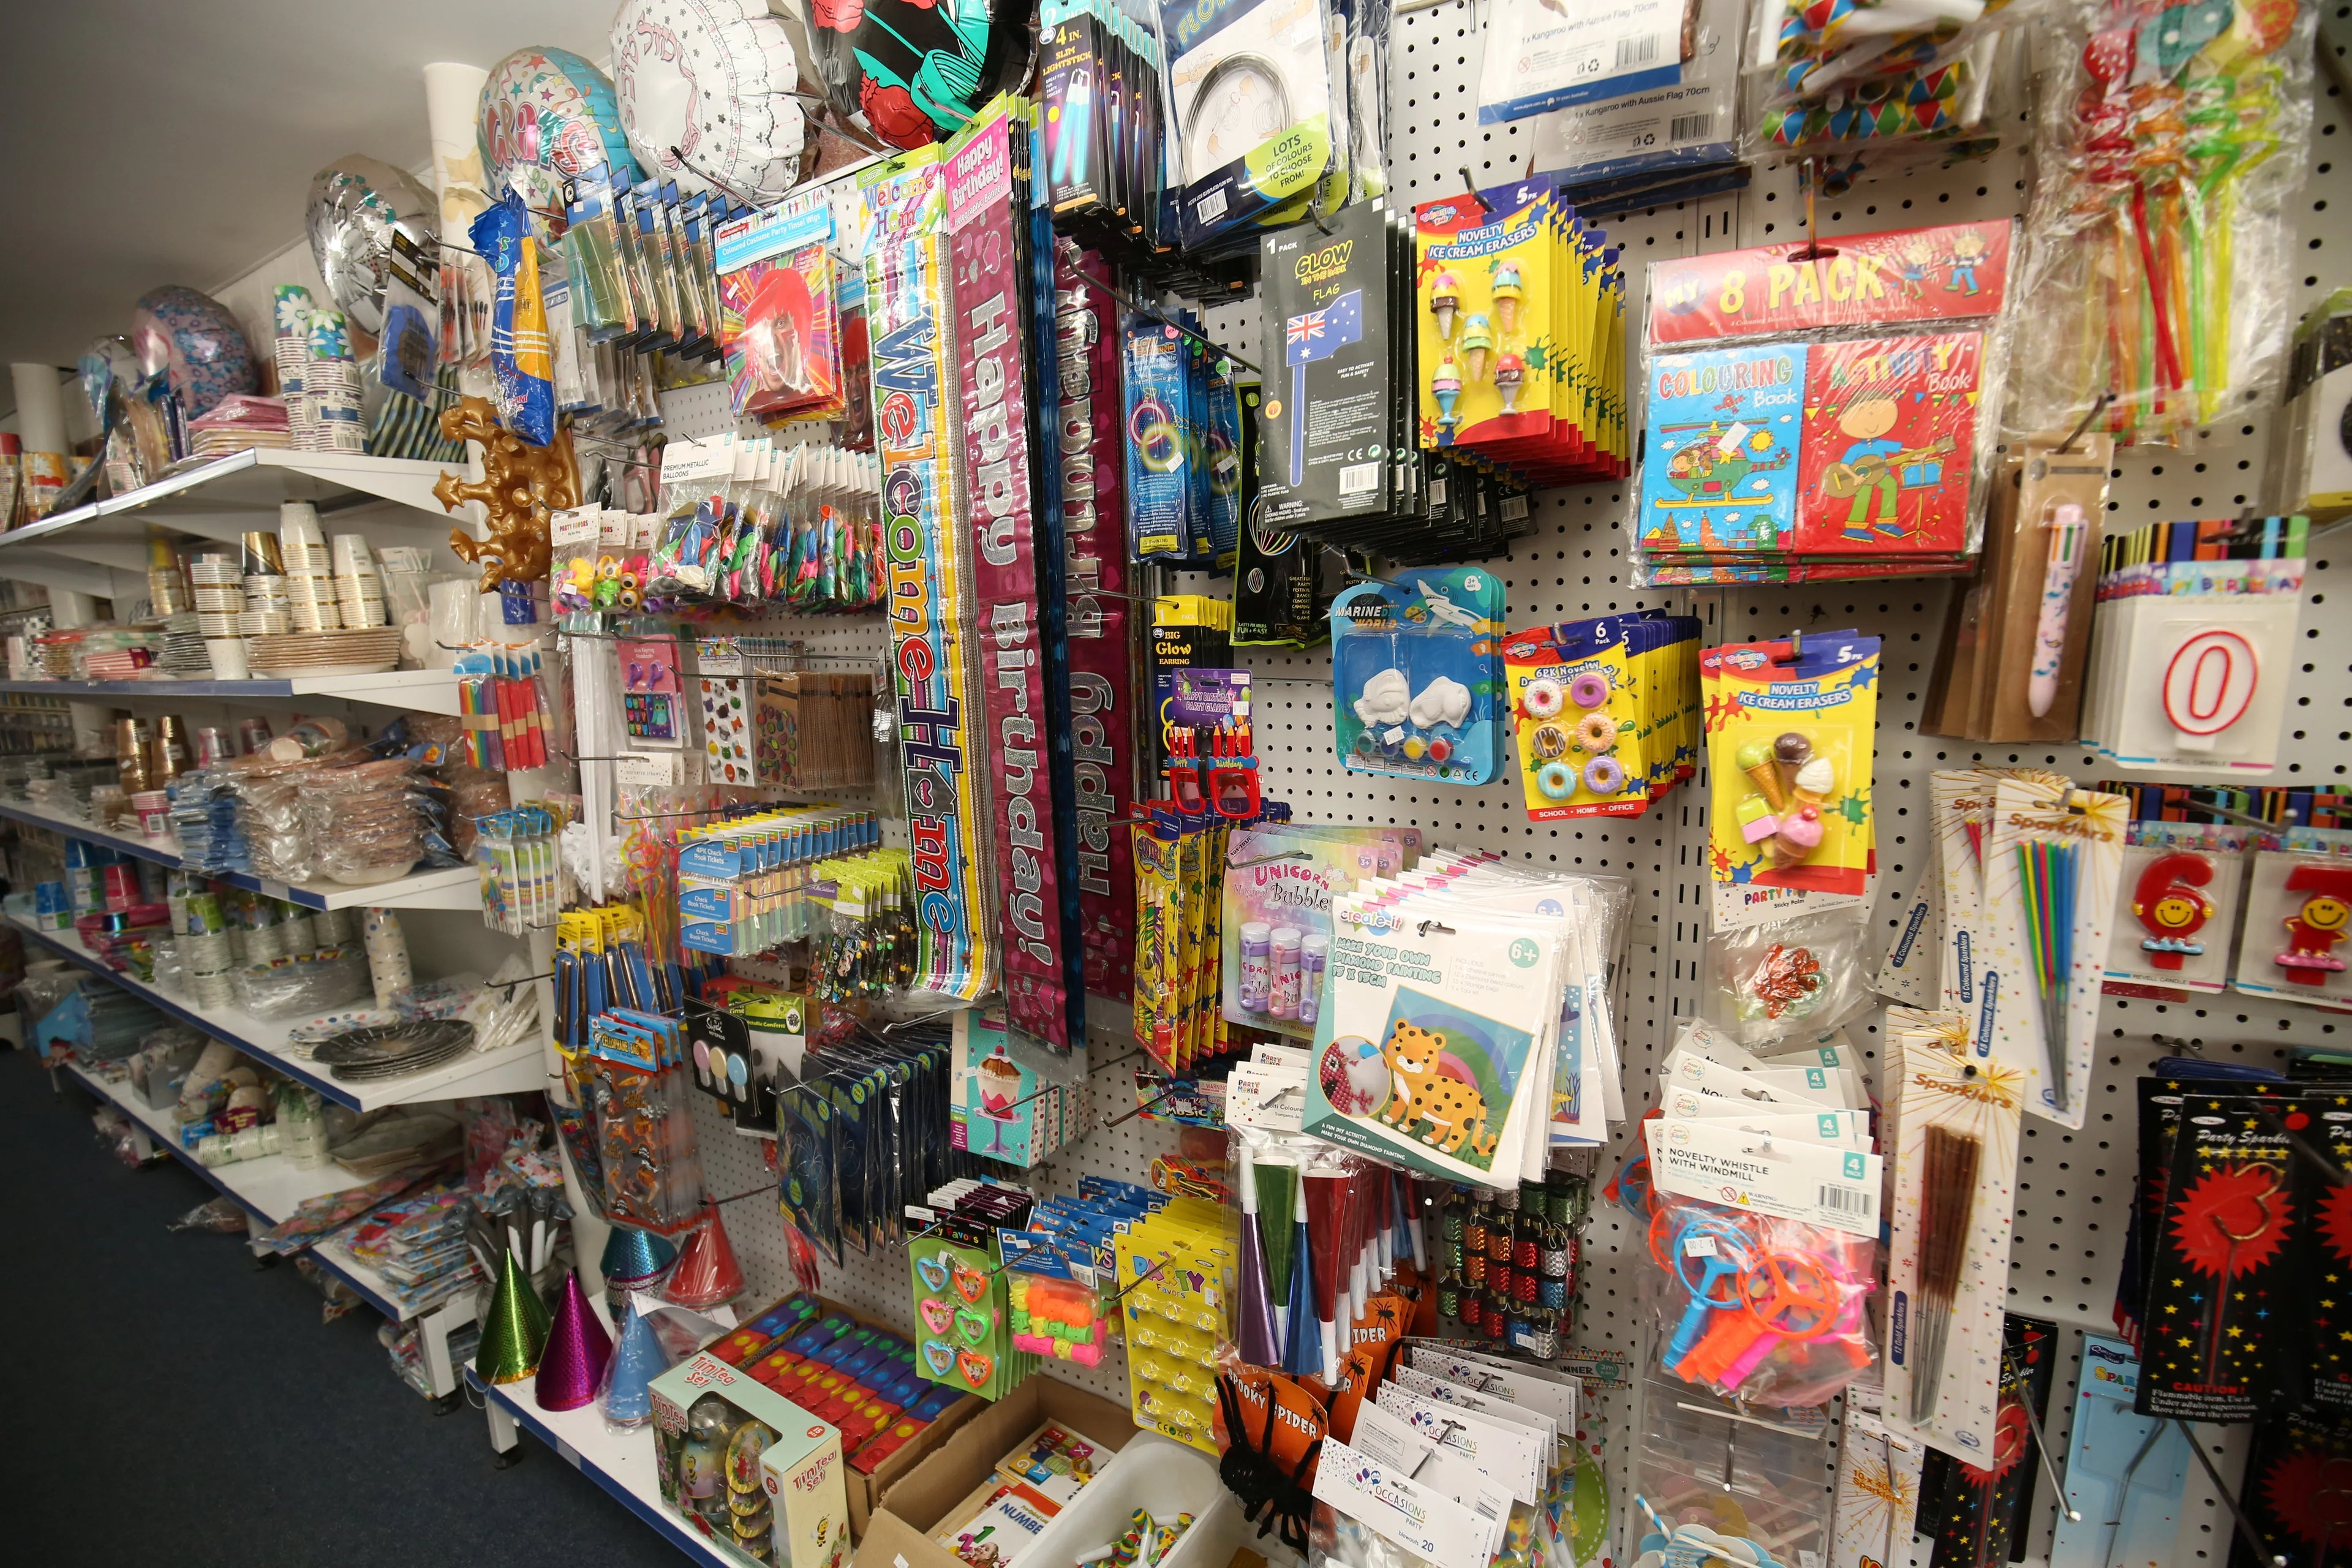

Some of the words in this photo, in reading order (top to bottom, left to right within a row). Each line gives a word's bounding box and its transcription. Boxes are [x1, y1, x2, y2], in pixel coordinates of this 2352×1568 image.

[1055, 26, 1066, 45] 4
[1069, 30, 1082, 42] IN.
[1055, 46, 1076, 60] SLIM
[1042, 51, 1091, 76] LIGHTSTICK
[1585, 104, 1619, 120] Kangaroo
[1621, 100, 1637, 111] with
[1638, 95, 1665, 108] Aussie
[1666, 90, 1684, 104] Flag
[1685, 85, 1710, 97] 70cm
[1272, 134, 1302, 157] LOTS
[956, 134, 992, 179] Happy
[1265, 162, 1277, 172] OF
[1280, 142, 1313, 167] COLOURS
[1269, 171, 1279, 182] TO
[1281, 155, 1313, 177] CHOOSE
[1280, 170, 1305, 187] FROM!
[951, 151, 1004, 212] Birthday!
[862, 172, 934, 213] Welcome
[954, 197, 984, 228] Holographic
[984, 183, 1005, 203] Banner
[722, 240, 746, 255] Coloured
[746, 232, 770, 246] Costume
[771, 225, 787, 236] Party
[788, 219, 805, 230] Tinsel
[806, 213, 820, 224] Wigs
[1429, 246, 1446, 258] ICE
[1447, 243, 1483, 258] CREAM
[1486, 225, 1536, 253] ERASERS
[1458, 223, 1503, 243] NOVELTY
[1267, 238, 1275, 254] 1
[1279, 241, 1297, 252] PACK
[1295, 239, 1353, 277] GLOW
[1301, 277, 1312, 285] IN
[1313, 271, 1326, 282] THE
[1328, 265, 1347, 276] DARK
[1664, 280, 1699, 307] MY
[1720, 270, 1746, 314] 8
[1768, 253, 1887, 309] PACK
[1313, 283, 1340, 301] FLAG
[1830, 342, 1954, 390] ACTIVITY
[1658, 355, 1793, 399] COLOURING
[1926, 368, 1972, 392] Book
[1754, 388, 1798, 406] Book
[971, 291, 1017, 566] Happy
[663, 463, 686, 472] PREMIUM
[686, 459, 709, 469] METALLIC
[663, 470, 689, 480] BALLOONS
[875, 303, 939, 682] Welcome
[1335, 606, 1382, 617] MARINE
[1355, 619, 1397, 629] WORLD
[1596, 622, 1607, 638] 6
[1156, 643, 1191, 655] Glow
[1536, 667, 1557, 678] 6PK
[1559, 660, 1599, 676] Novelty
[1771, 684, 1818, 695] NOVELTY
[2162, 630, 2258, 735] 0
[1184, 692, 1202, 701] HAPPY
[1204, 692, 1234, 701] BIRTHDAY
[1739, 693, 1755, 705] ICE
[1758, 696, 1795, 708] CREAM
[1798, 690, 1850, 707] ERASERS
[1186, 702, 1204, 711] PARTY
[1206, 703, 1230, 712] GLASSES
[991, 602, 1053, 967] Birthday!
[2007, 813, 2114, 842] Sparklers
[707, 848, 722, 857] Check
[1229, 835, 1253, 858] NON-TOXIC
[707, 855, 725, 865] Tickets
[1253, 863, 1330, 891] UNICORN
[699, 902, 715, 911] Tickets
[1745, 888, 1782, 905] PARTY
[1340, 910, 1403, 931] create-it
[701, 935, 717, 944] Tickets
[1961, 935, 1969, 960] Sparklers
[1337, 938, 1363, 952] MAKE
[1366, 943, 1396, 959] YOUR
[1400, 950, 1430, 966] OWN
[1511, 944, 1537, 962] 6+
[1332, 967, 1343, 976] 15
[1347, 970, 1355, 980] X
[1357, 973, 1387, 987] 15CM
[1334, 952, 1383, 971] DIAMOND
[1386, 963, 1441, 984] PAINTING
[601, 1033, 628, 1053] CELLOPHANE
[1262, 1053, 1283, 1062] PARTY
[1825, 1052, 1834, 1060] 4
[1811, 1072, 1821, 1082] 4
[1237, 1086, 1259, 1095] MAKER
[1913, 1073, 2012, 1109] Sparklers
[1823, 1118, 1834, 1129] 4
[1334, 1133, 1346, 1142] YOUR
[1360, 1141, 1382, 1153] DIAMOND
[1384, 1149, 1406, 1161] PAINTING
[1669, 1157, 1697, 1170] WITH
[1700, 1164, 1755, 1182] WINDMILL
[1670, 1148, 1716, 1165] NOVELTY
[1721, 1158, 1770, 1175] WHISTLE
[1847, 1158, 1860, 1171] 4
[1133, 1255, 1205, 1293] PARTY
[1156, 1283, 1186, 1298] Favors
[684, 1370, 711, 1387] Set
[1227, 1367, 1267, 1409] SPOOKY
[662, 1415, 679, 1436] Set
[1460, 1450, 1476, 1461] PARTY
[805, 1471, 825, 1493] Set
[1375, 1485, 1426, 1520] OCCASIONS
[1406, 1518, 1422, 1531] PARTY
[1398, 1530, 1419, 1547] blowouts
[1422, 1539, 1434, 1553] 20
